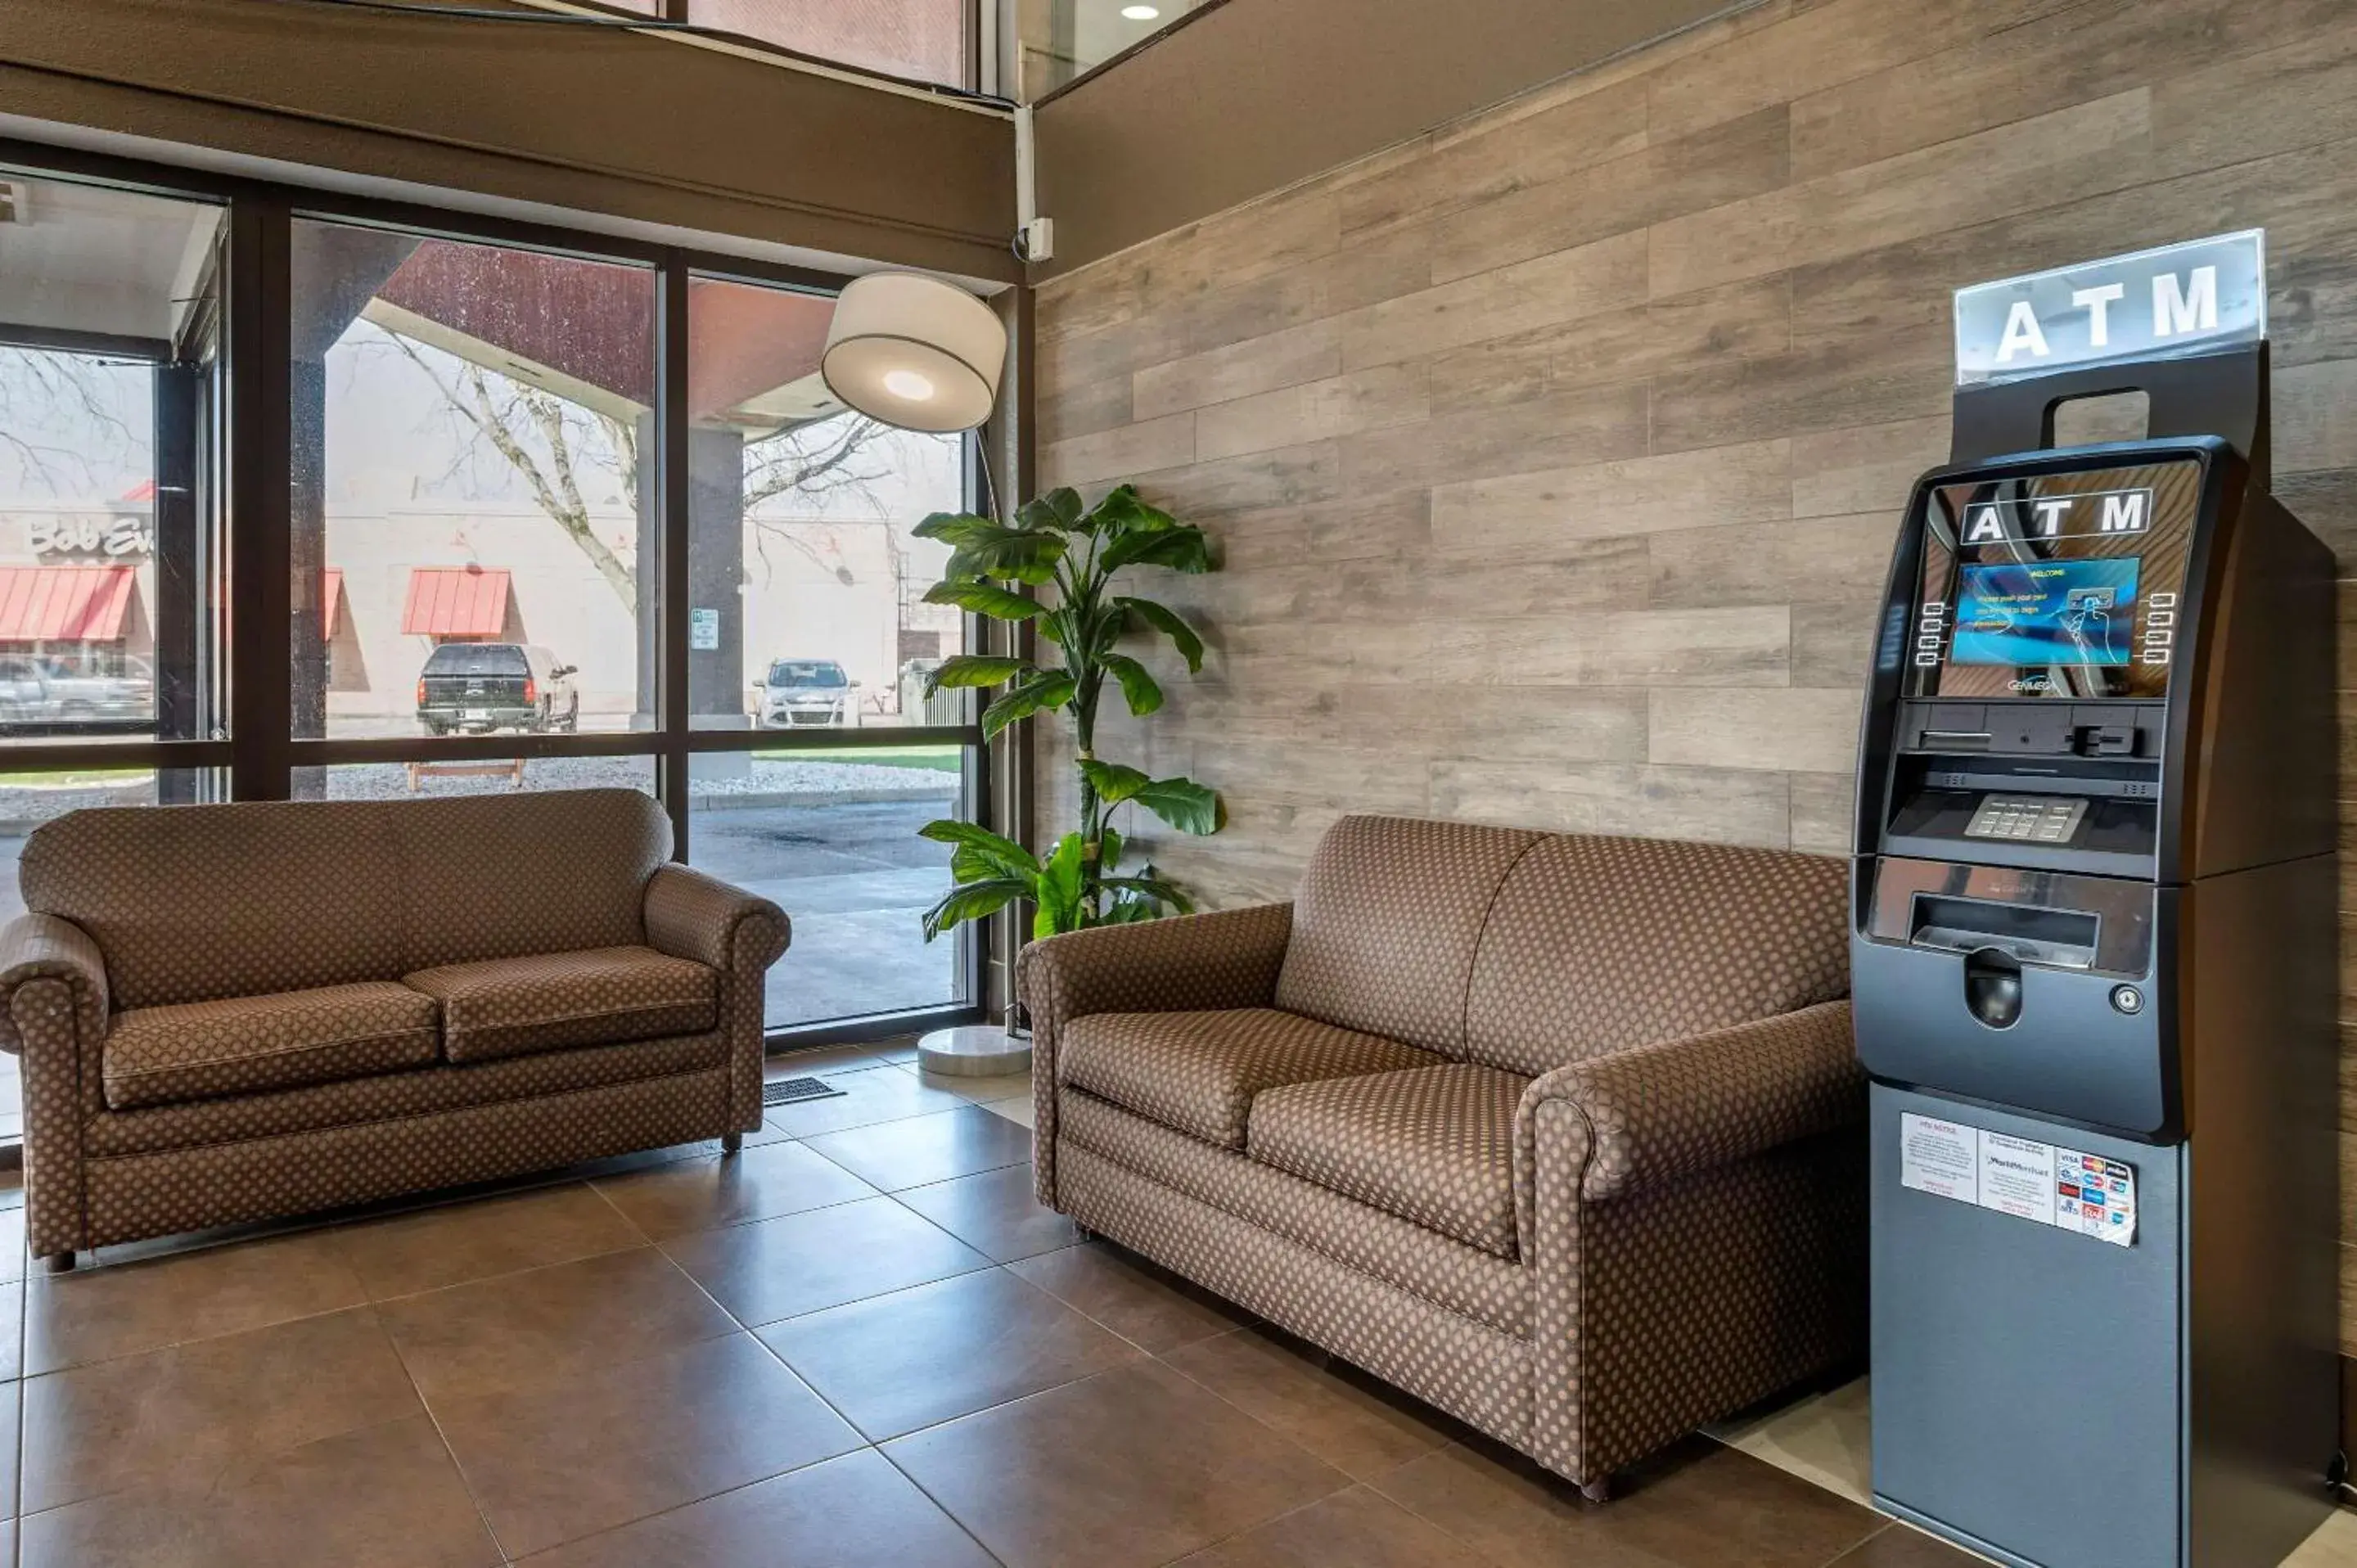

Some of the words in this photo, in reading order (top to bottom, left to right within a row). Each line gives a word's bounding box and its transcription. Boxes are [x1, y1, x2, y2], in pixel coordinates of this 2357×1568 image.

[1995, 265, 2218, 363] ATM
[31, 516, 100, 552] Bob
[1968, 493, 2143, 541] ATM
[2061, 1155, 2078, 1163] VISA
